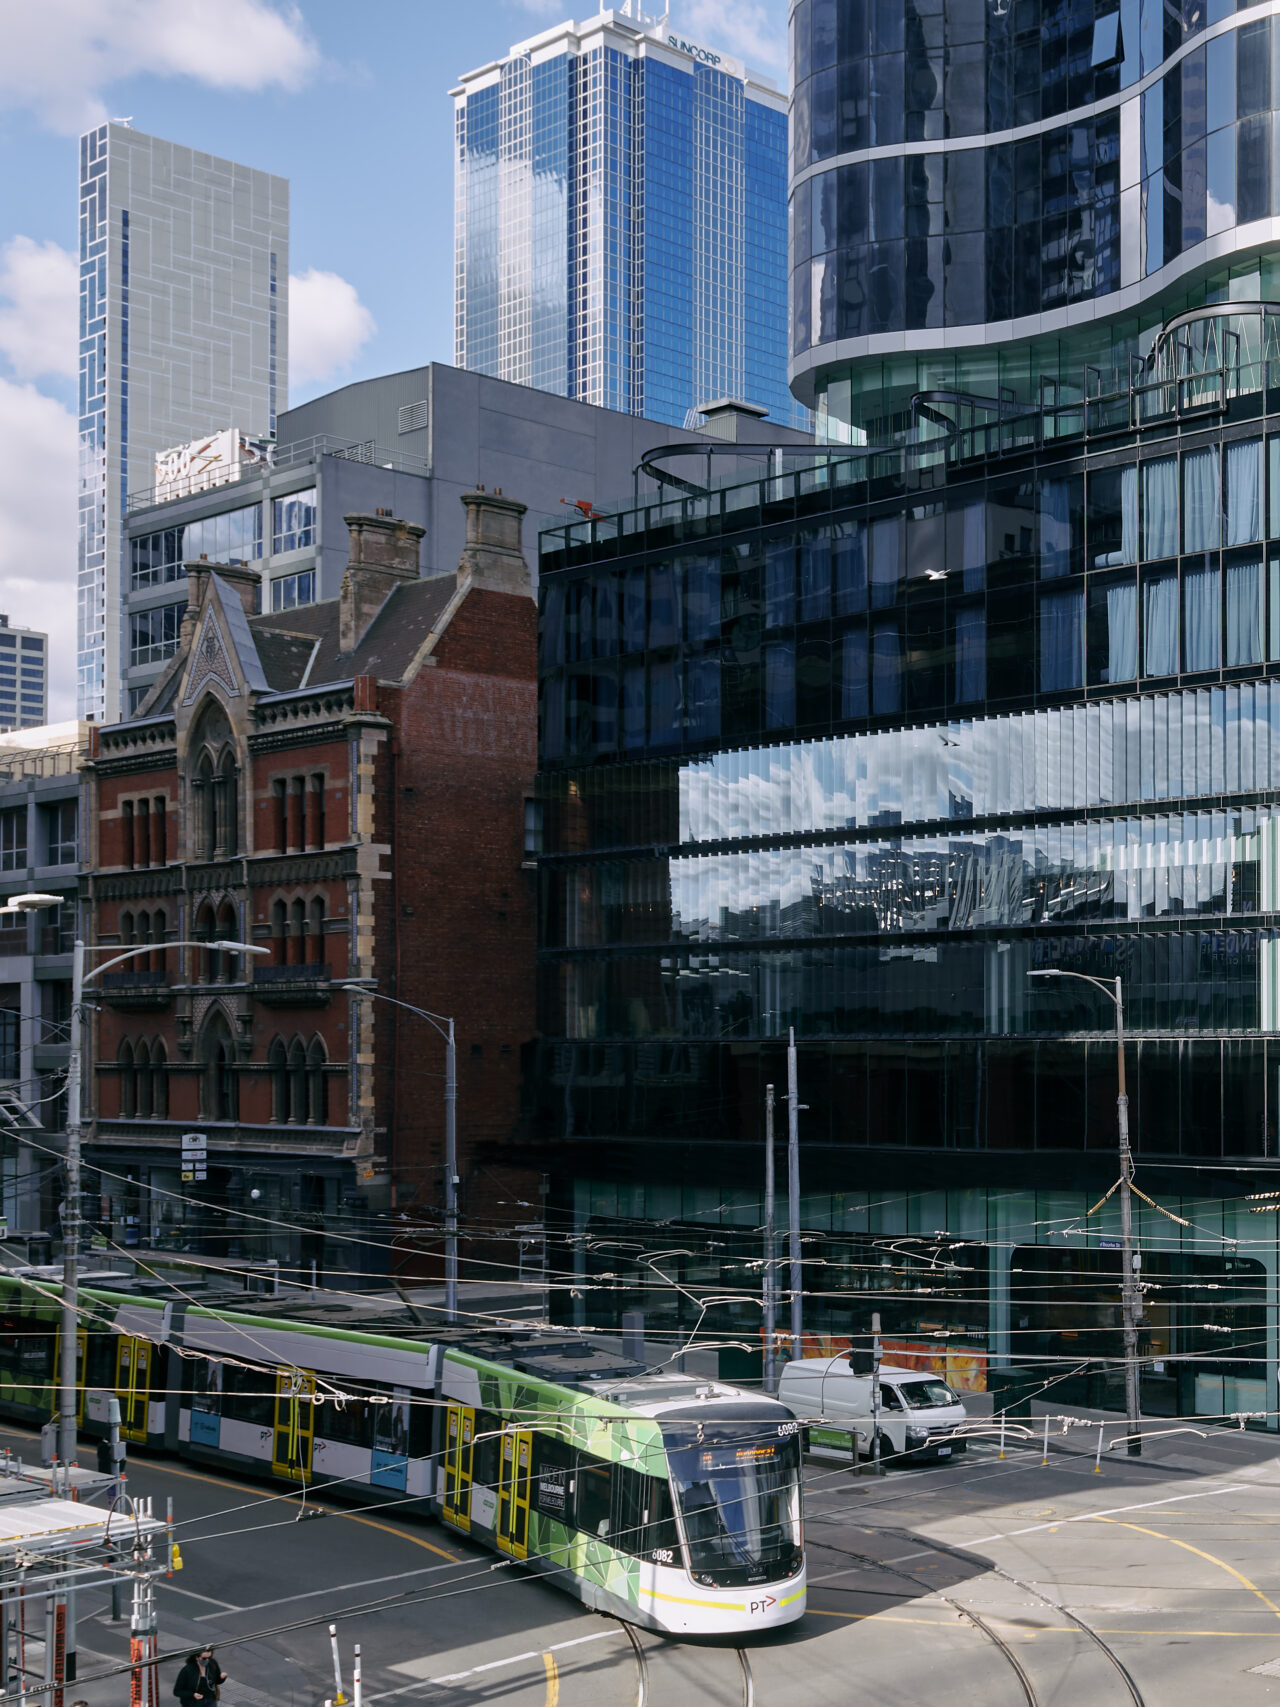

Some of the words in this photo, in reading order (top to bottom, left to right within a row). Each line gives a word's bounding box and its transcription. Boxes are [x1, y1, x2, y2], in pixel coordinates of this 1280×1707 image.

[668, 35, 721, 66] SUNCORP
[777, 1422, 799, 1437] 6082
[652, 1549, 673, 1563] 6082
